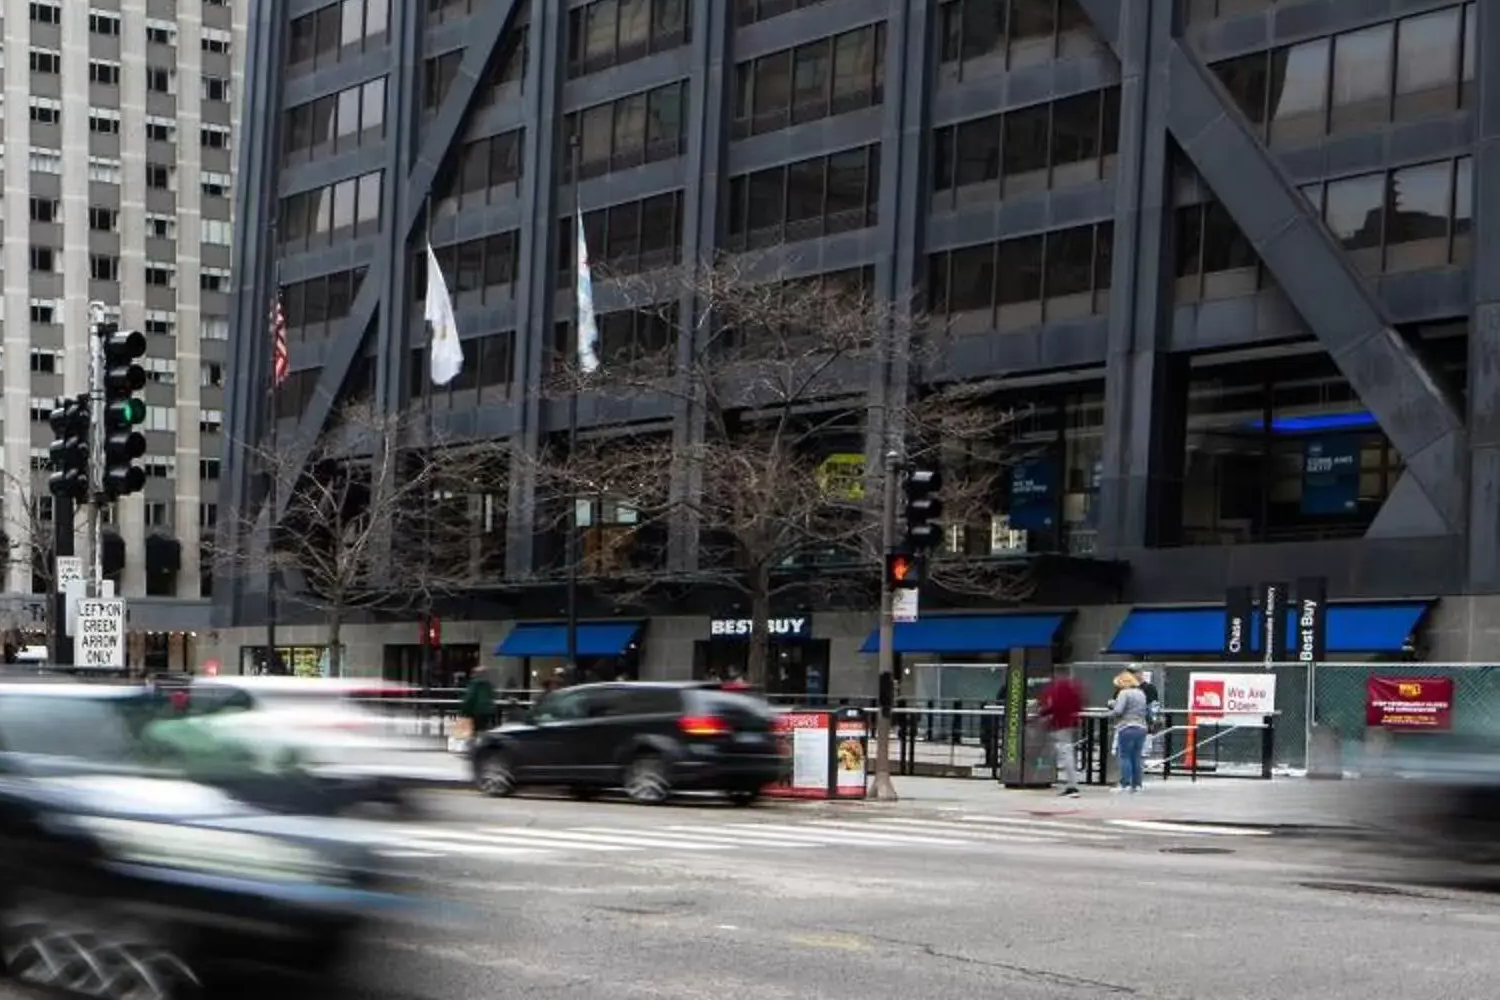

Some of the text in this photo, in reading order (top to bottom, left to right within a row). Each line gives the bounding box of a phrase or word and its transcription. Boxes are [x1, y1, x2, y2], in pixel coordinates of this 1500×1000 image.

[79, 603, 121, 617] LEFT ON
[83, 619, 117, 633] GREEN
[711, 619, 753, 635] BEST
[1300, 599, 1317, 661] Best Buy
[81, 635, 117, 648] ARROW
[1229, 617, 1242, 653] Chase
[85, 650, 113, 664] ONLY
[1228, 687, 1267, 699] We Are
